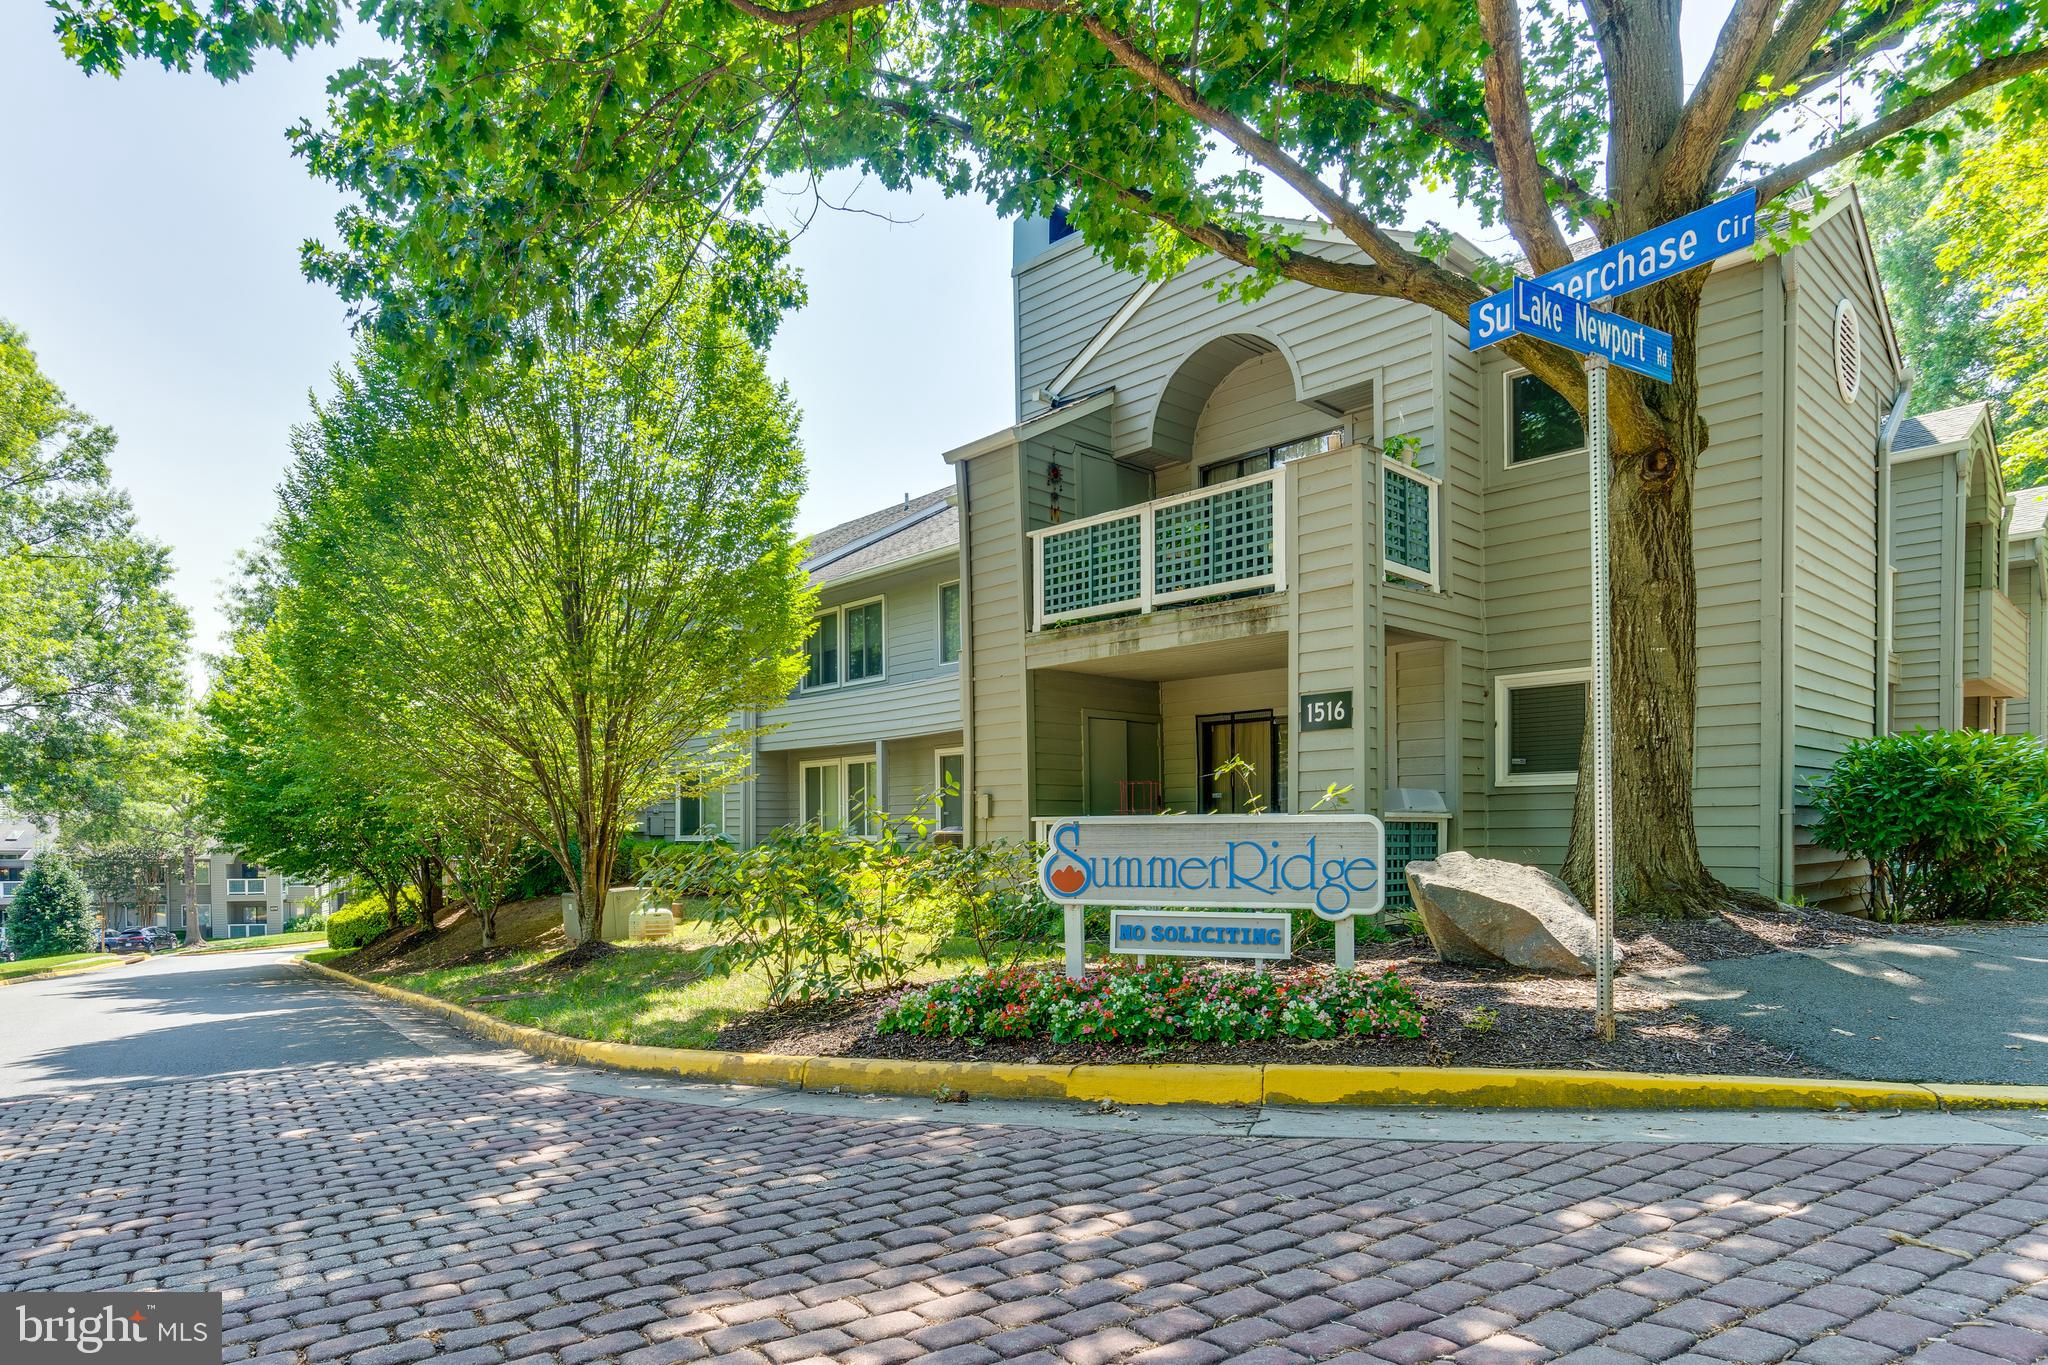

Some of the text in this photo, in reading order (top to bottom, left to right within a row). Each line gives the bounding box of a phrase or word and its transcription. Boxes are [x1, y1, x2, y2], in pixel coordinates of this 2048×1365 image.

[1478, 214, 1752, 338] Suerchase Cir
[1519, 281, 1668, 368] Lake Newport Rd
[1307, 700, 1345, 723] 1516
[1046, 820, 1377, 914] SummerRidge
[1119, 924, 1281, 946] NO SOLICITING
